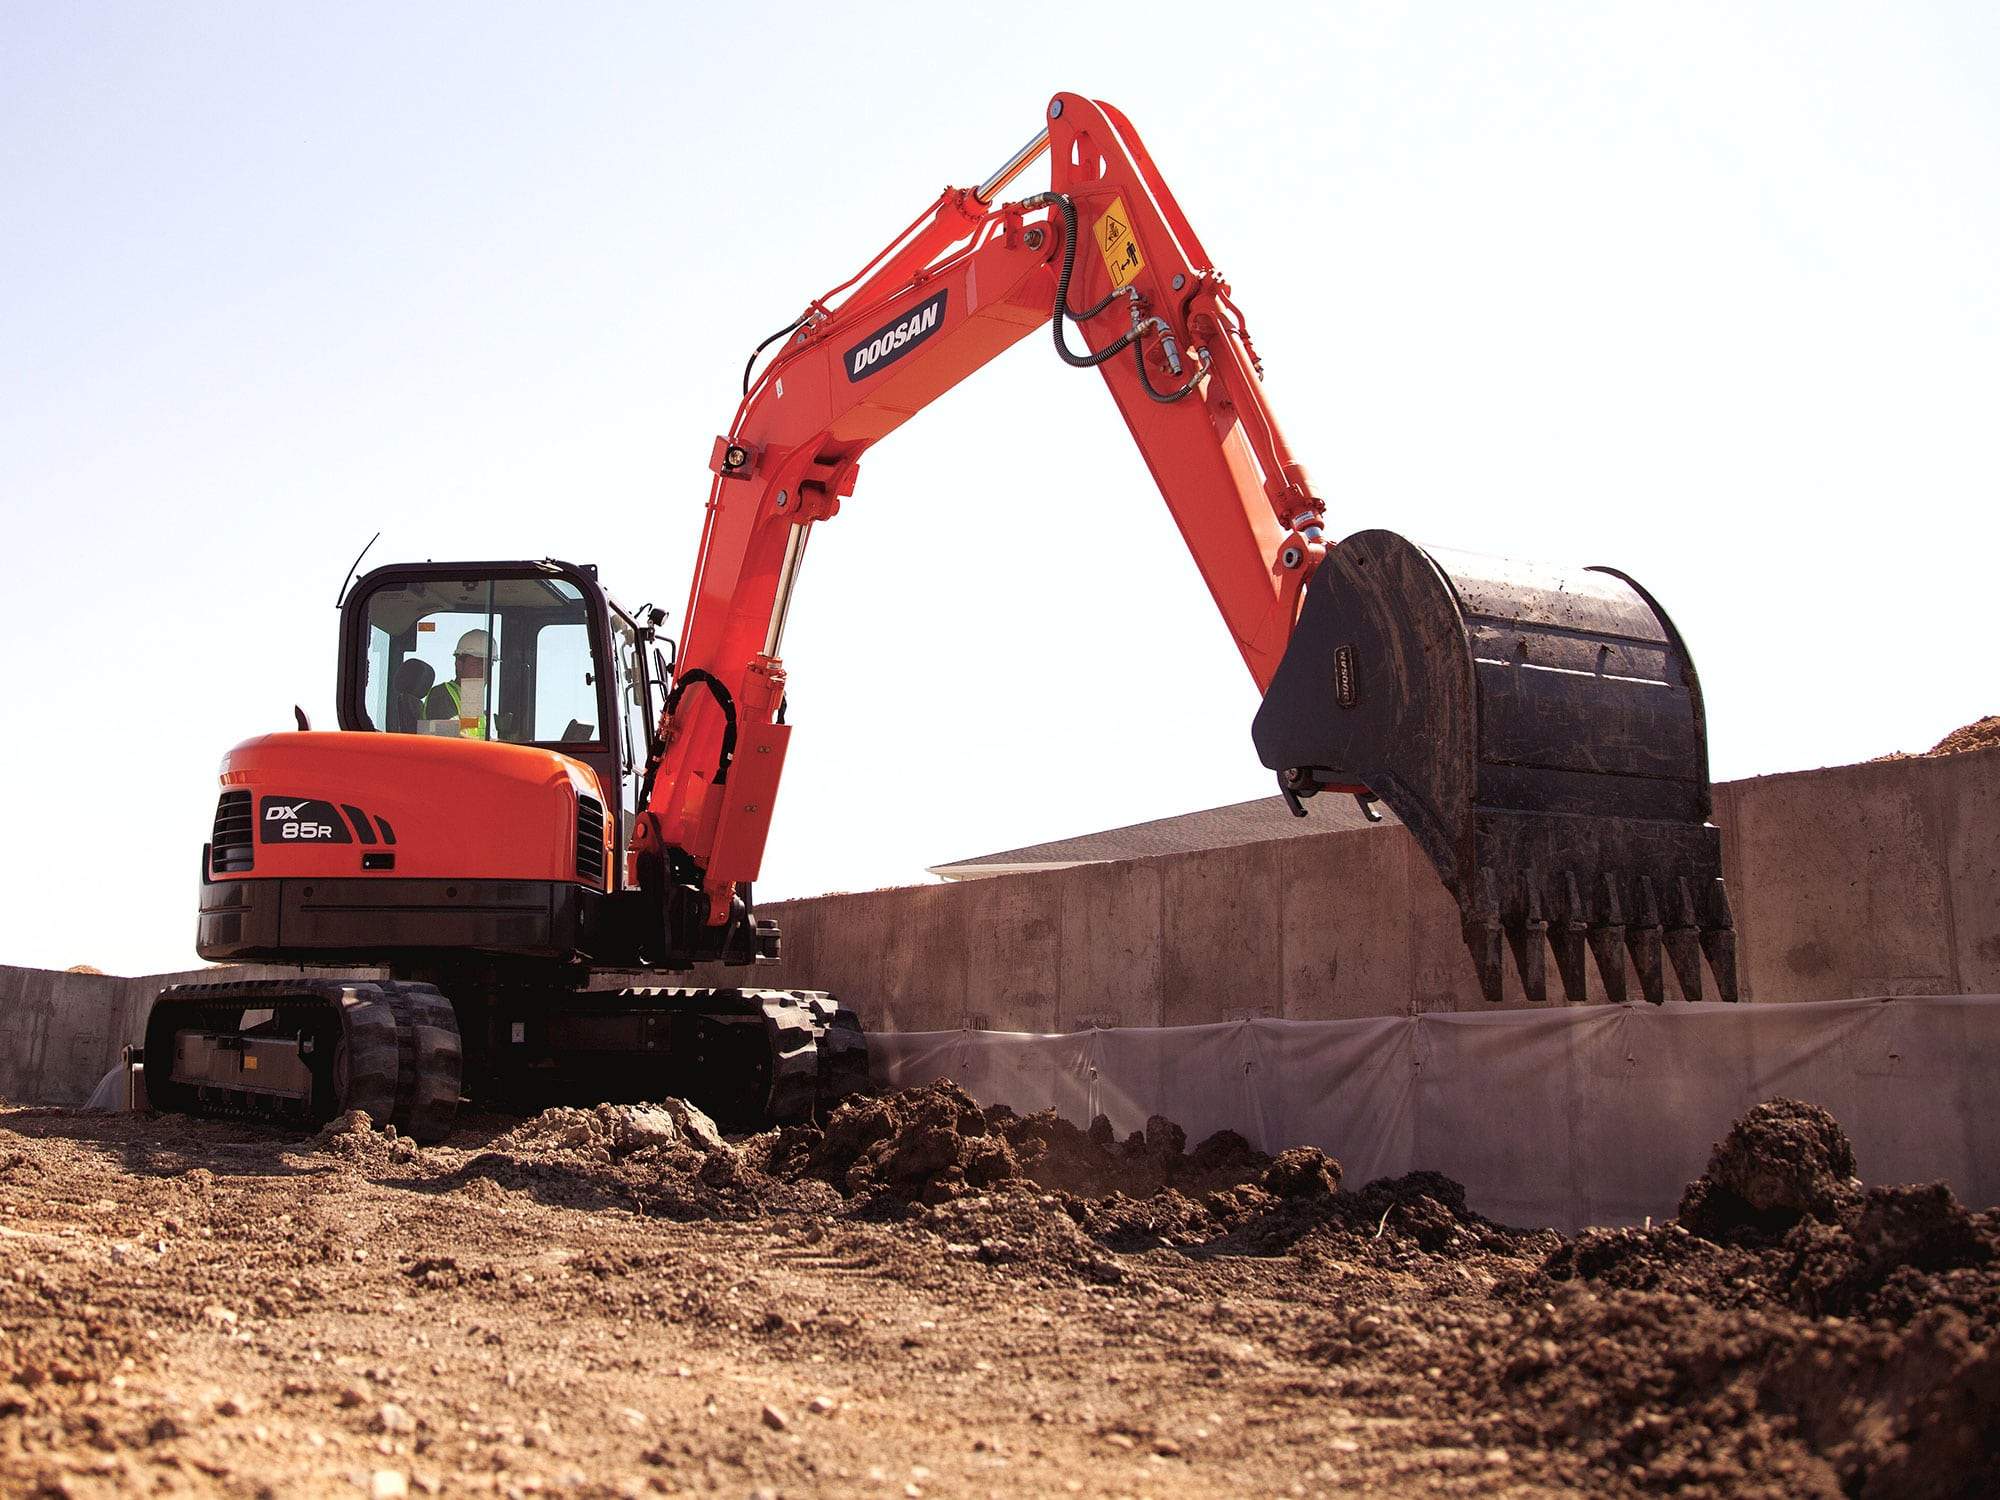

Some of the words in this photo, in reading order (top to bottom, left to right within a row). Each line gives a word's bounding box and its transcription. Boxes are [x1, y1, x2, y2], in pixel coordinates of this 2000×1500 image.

[853, 302, 939, 375] DOOSAN
[265, 801, 310, 821] DX
[282, 822, 333, 839] 85R
